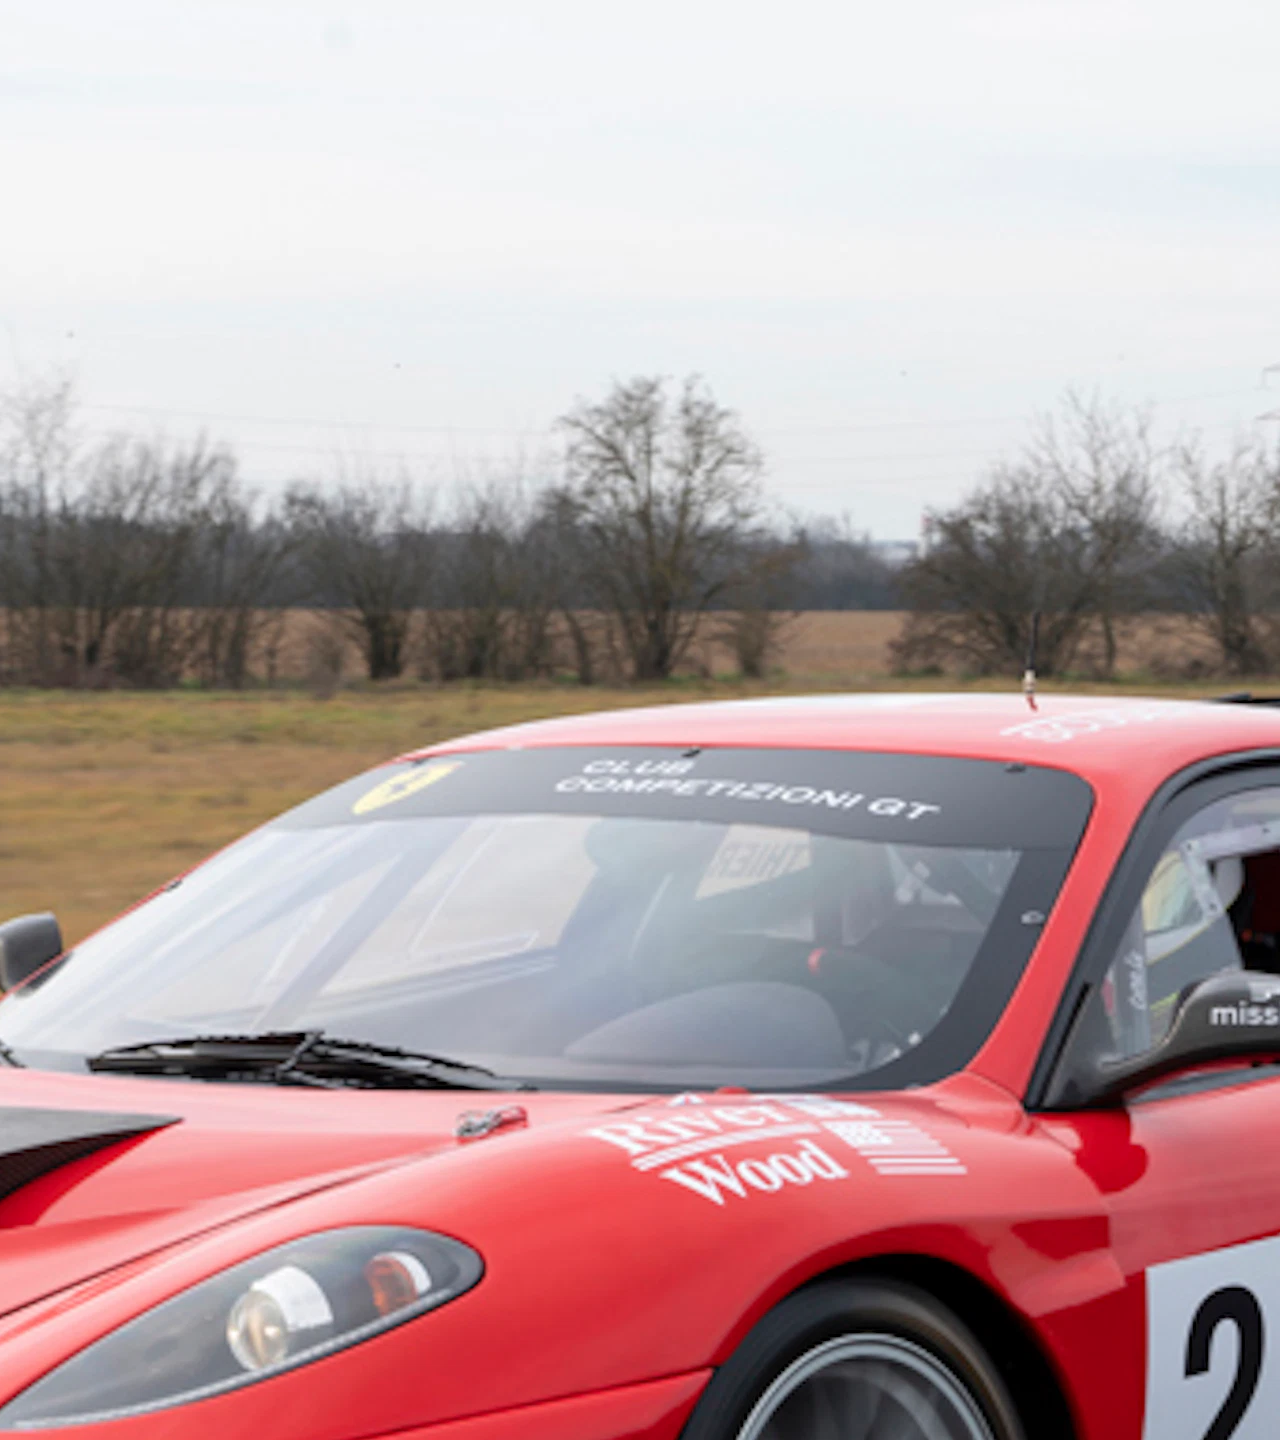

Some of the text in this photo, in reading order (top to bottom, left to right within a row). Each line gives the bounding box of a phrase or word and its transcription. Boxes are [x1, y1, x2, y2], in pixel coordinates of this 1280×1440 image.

[583, 760, 694, 775] CLUB
[554, 775, 941, 820] COMPETIZIONI GT
[585, 1103, 792, 1156] River
[659, 1139, 850, 1206] Wood
